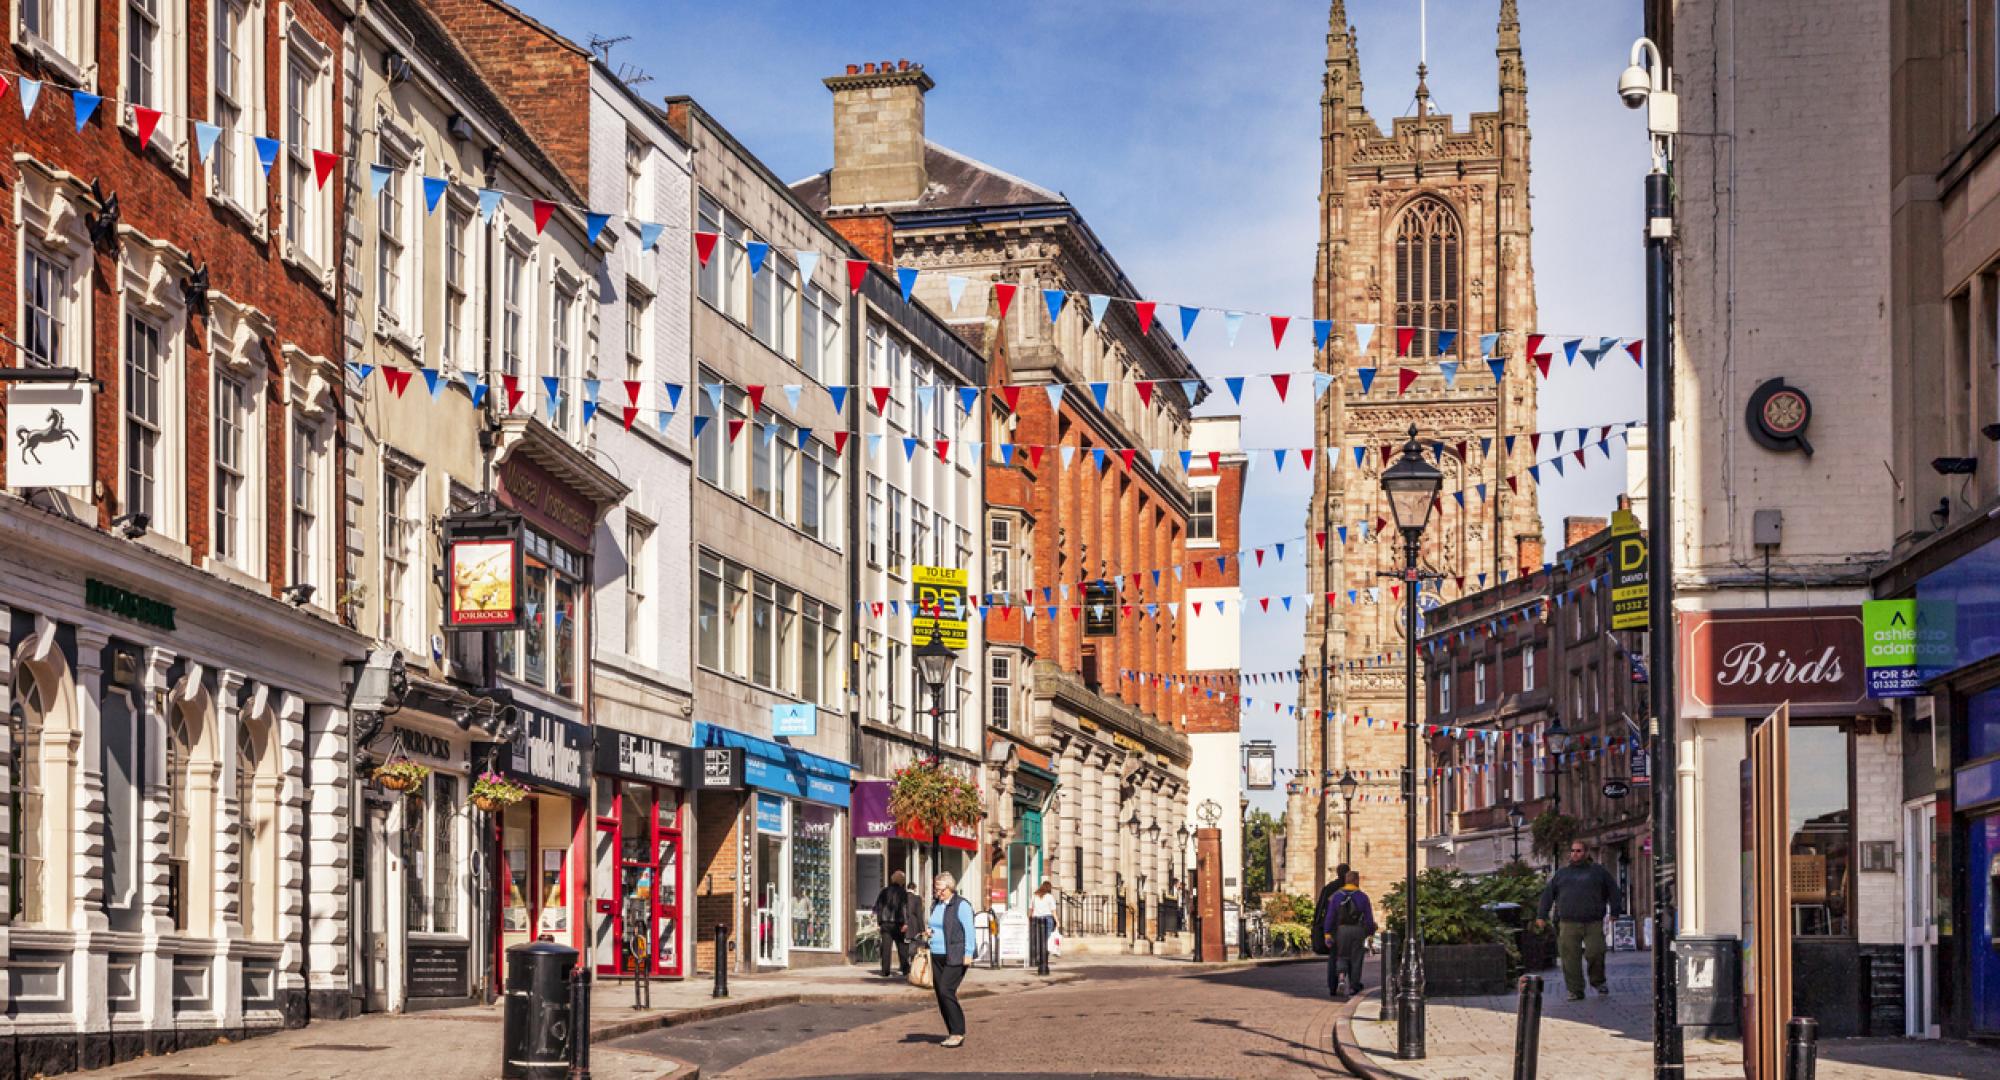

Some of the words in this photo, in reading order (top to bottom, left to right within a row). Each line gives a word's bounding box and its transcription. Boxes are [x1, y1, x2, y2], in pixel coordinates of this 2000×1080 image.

[1621, 540, 1648, 571] D
[927, 567, 938, 577] TO
[941, 569, 956, 578] LET
[1621, 573, 1643, 584] DAVID
[1615, 602, 1642, 612] 01332
[458, 611, 509, 621] JORROCKS
[1717, 642, 1844, 685] Birds
[1873, 670, 1898, 680] FOR
[1873, 680, 1899, 689] 01332
